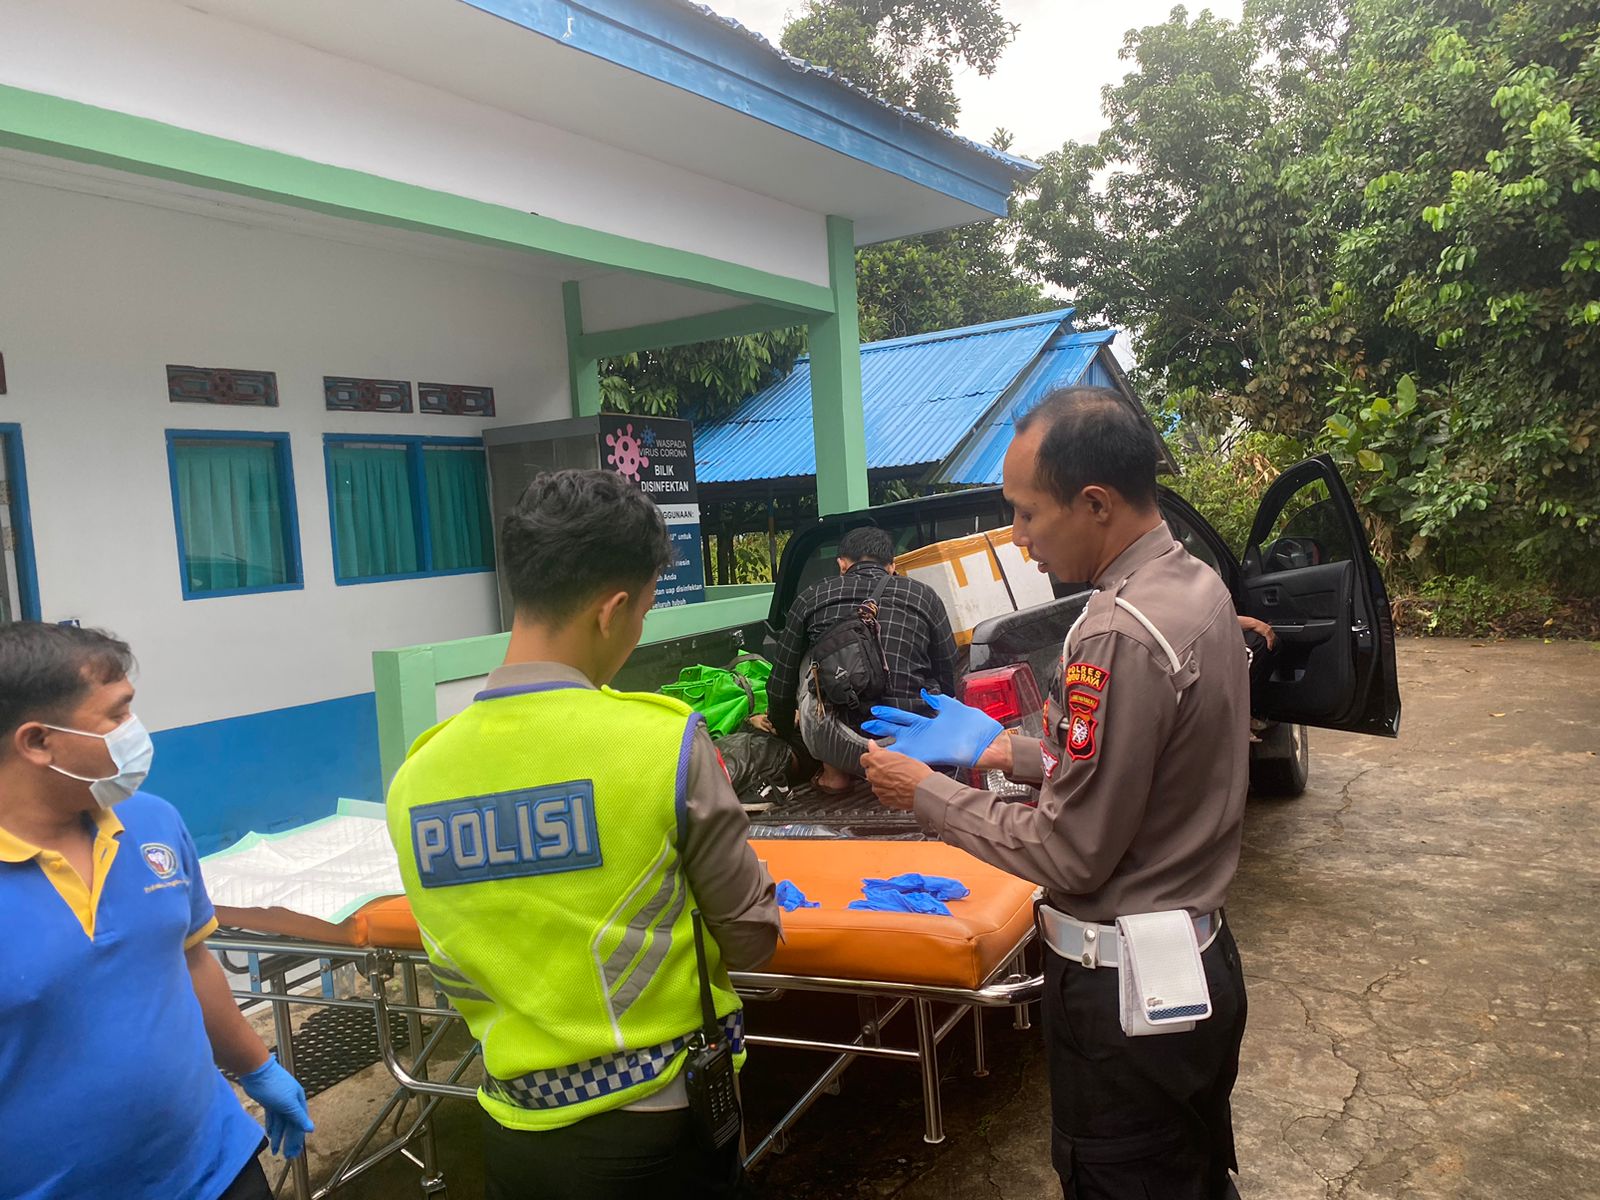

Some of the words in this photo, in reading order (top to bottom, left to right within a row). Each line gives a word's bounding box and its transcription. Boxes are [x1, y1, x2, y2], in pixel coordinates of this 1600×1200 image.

[656, 439, 687, 448] WASPADA
[640, 447, 659, 457] VIRUS
[660, 448, 688, 458] CORONA
[654, 464, 674, 476] BILIK
[641, 480, 689, 492] DISINFEKTAN
[1067, 665, 1102, 679] POLRES
[1081, 673, 1100, 688] RAYA
[415, 795, 591, 874] POLISI
